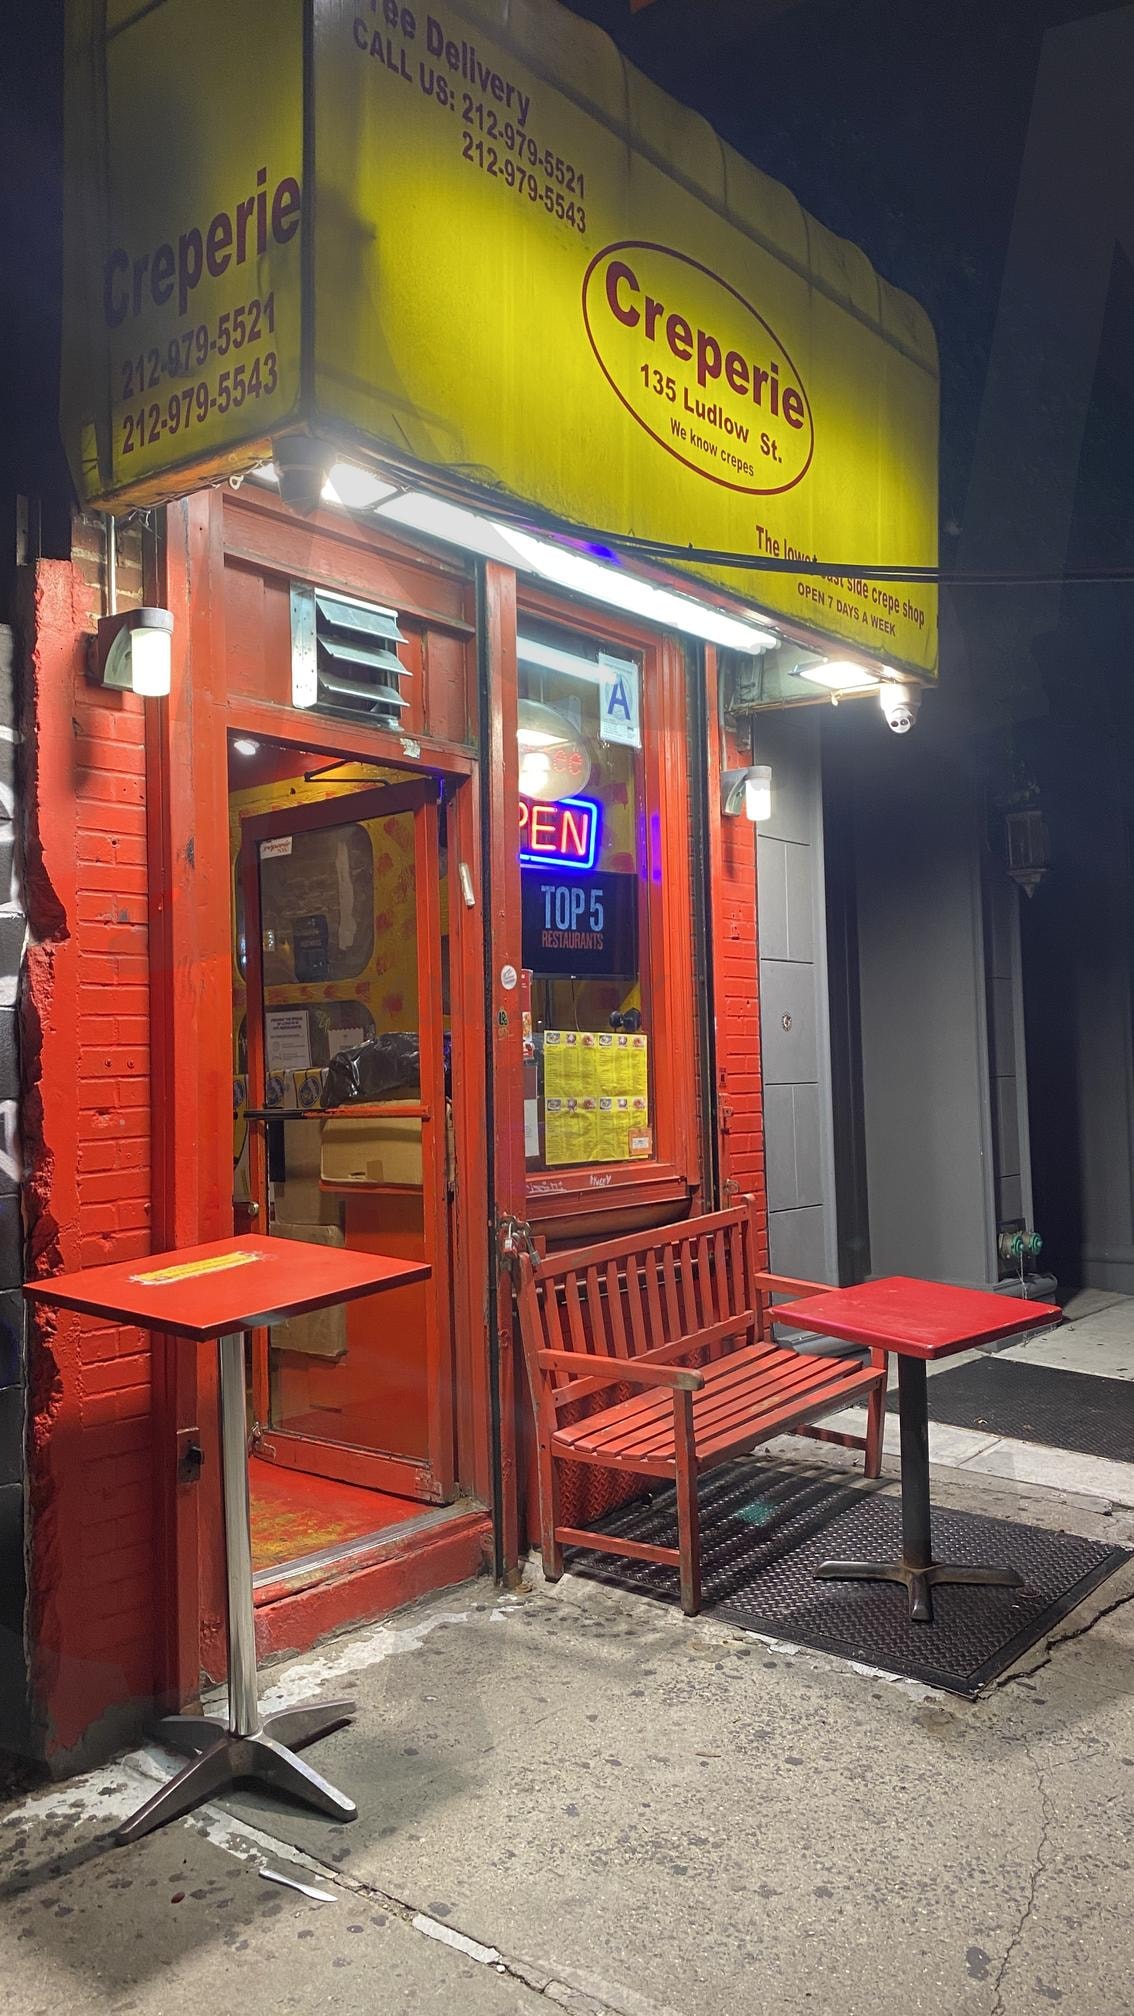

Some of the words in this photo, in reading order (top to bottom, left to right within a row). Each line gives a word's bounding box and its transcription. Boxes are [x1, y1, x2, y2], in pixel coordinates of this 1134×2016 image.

[352, 17, 412, 83] CALL
[419, 61, 455, 111] US:
[462, 93, 584, 200] 212-979-5521
[426, 15, 530, 127] Delivery
[462, 130, 586, 234] 212-979-5543
[103, 166, 302, 329] Creperie
[122, 291, 276, 401] 212-979-5521
[605, 260, 805, 430] Creperie
[122, 351, 278, 454] 212-979-5543
[640, 363, 677, 403] 135
[683, 386, 749, 443] Ludlow
[760, 432, 783, 464] St.
[670, 417, 687, 440] We
[690, 428, 718, 456] know
[720, 449, 755, 477] crepes
[756, 525, 780, 557] The
[847, 577, 869, 598] side
[872, 586, 900, 615] crepe
[903, 600, 925, 630] shop
[797, 582, 825, 606] OPEN
[828, 595, 833, 609] 7
[837, 600, 859, 621] DAYS
[862, 614, 868, 625] A
[871, 615, 896, 637] WEEK
[607, 674, 631, 721] A
[541, 885, 585, 930] TOP
[589, 888, 604, 932] 5
[542, 930, 604, 950] RESTAURANTS
